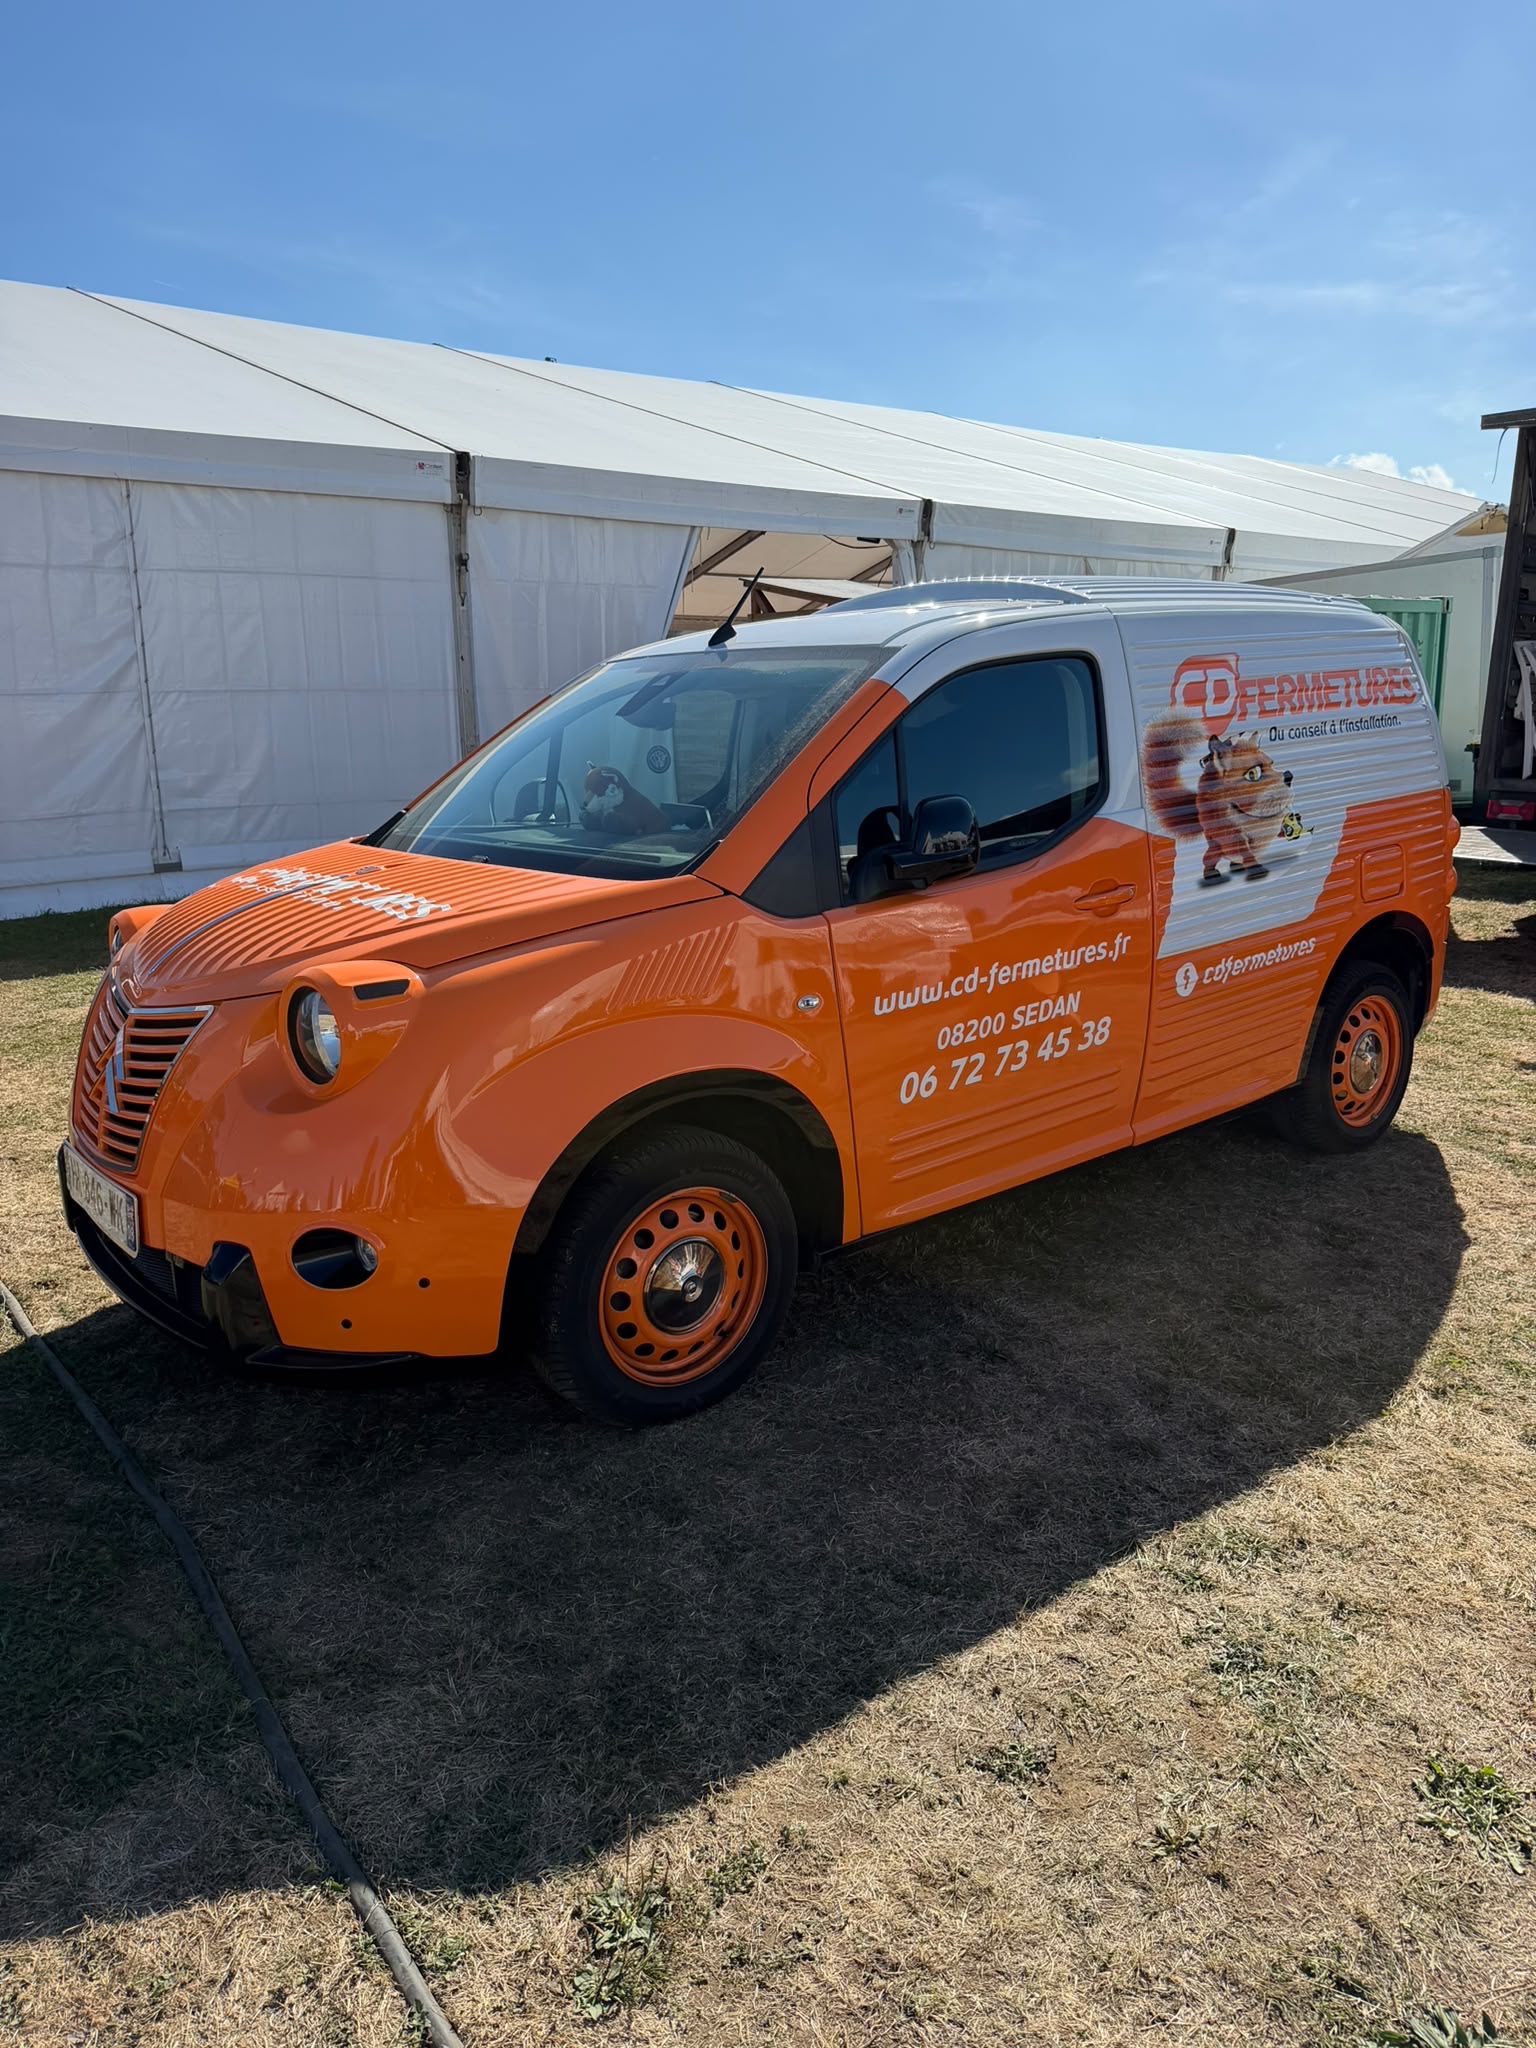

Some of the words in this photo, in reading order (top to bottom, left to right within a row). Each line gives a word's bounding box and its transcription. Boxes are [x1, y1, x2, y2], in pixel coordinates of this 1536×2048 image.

[1173, 665, 1238, 719] CD
[1237, 667, 1419, 721] FERMETURES
[1288, 721, 1327, 739] conseil
[1329, 720, 1337, 735] à
[1339, 714, 1402, 733] l'installation.
[873, 932, 1132, 1016] www.cd-fermetures.fr
[1202, 937, 1317, 984] cdfermetures
[936, 1013, 1004, 1050] 08200
[1011, 991, 1081, 1031] SEDAN
[900, 1070, 937, 1104] 06
[948, 1054, 983, 1091] 72
[994, 1040, 1028, 1077] 73
[1036, 1028, 1072, 1063] 45
[1078, 1016, 1112, 1051] 38
